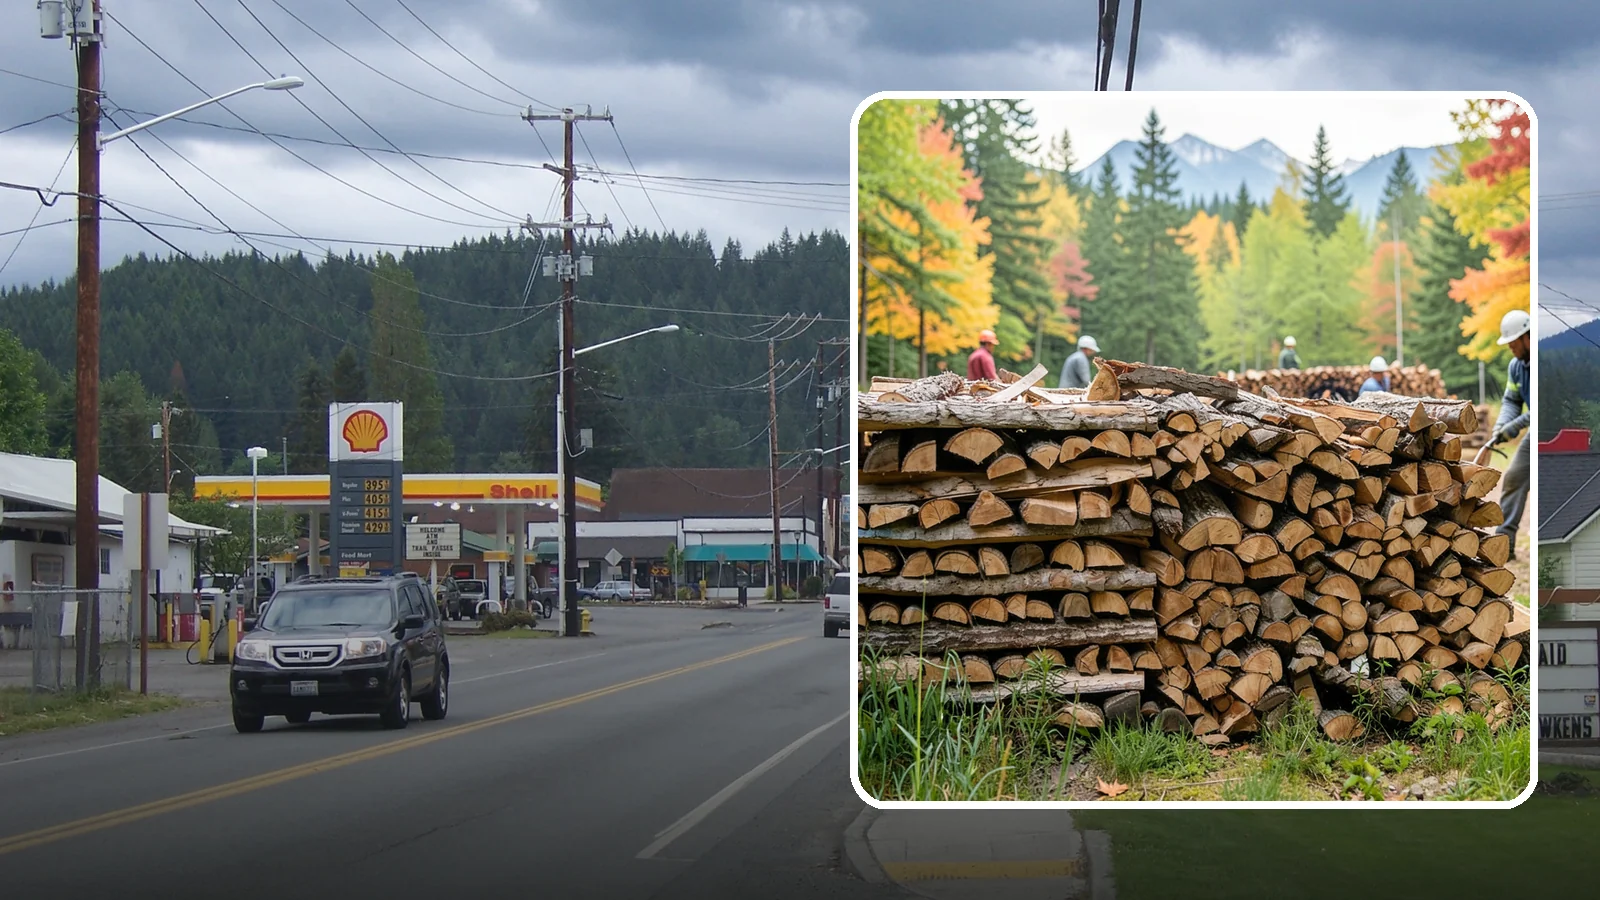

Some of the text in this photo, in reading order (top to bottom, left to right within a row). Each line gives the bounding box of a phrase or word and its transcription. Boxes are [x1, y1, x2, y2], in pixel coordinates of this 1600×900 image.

[365, 480, 384, 490] 395
[489, 484, 547, 499] Shell
[365, 494, 384, 504] 405
[365, 508, 384, 518] 415
[365, 522, 384, 532] 429
